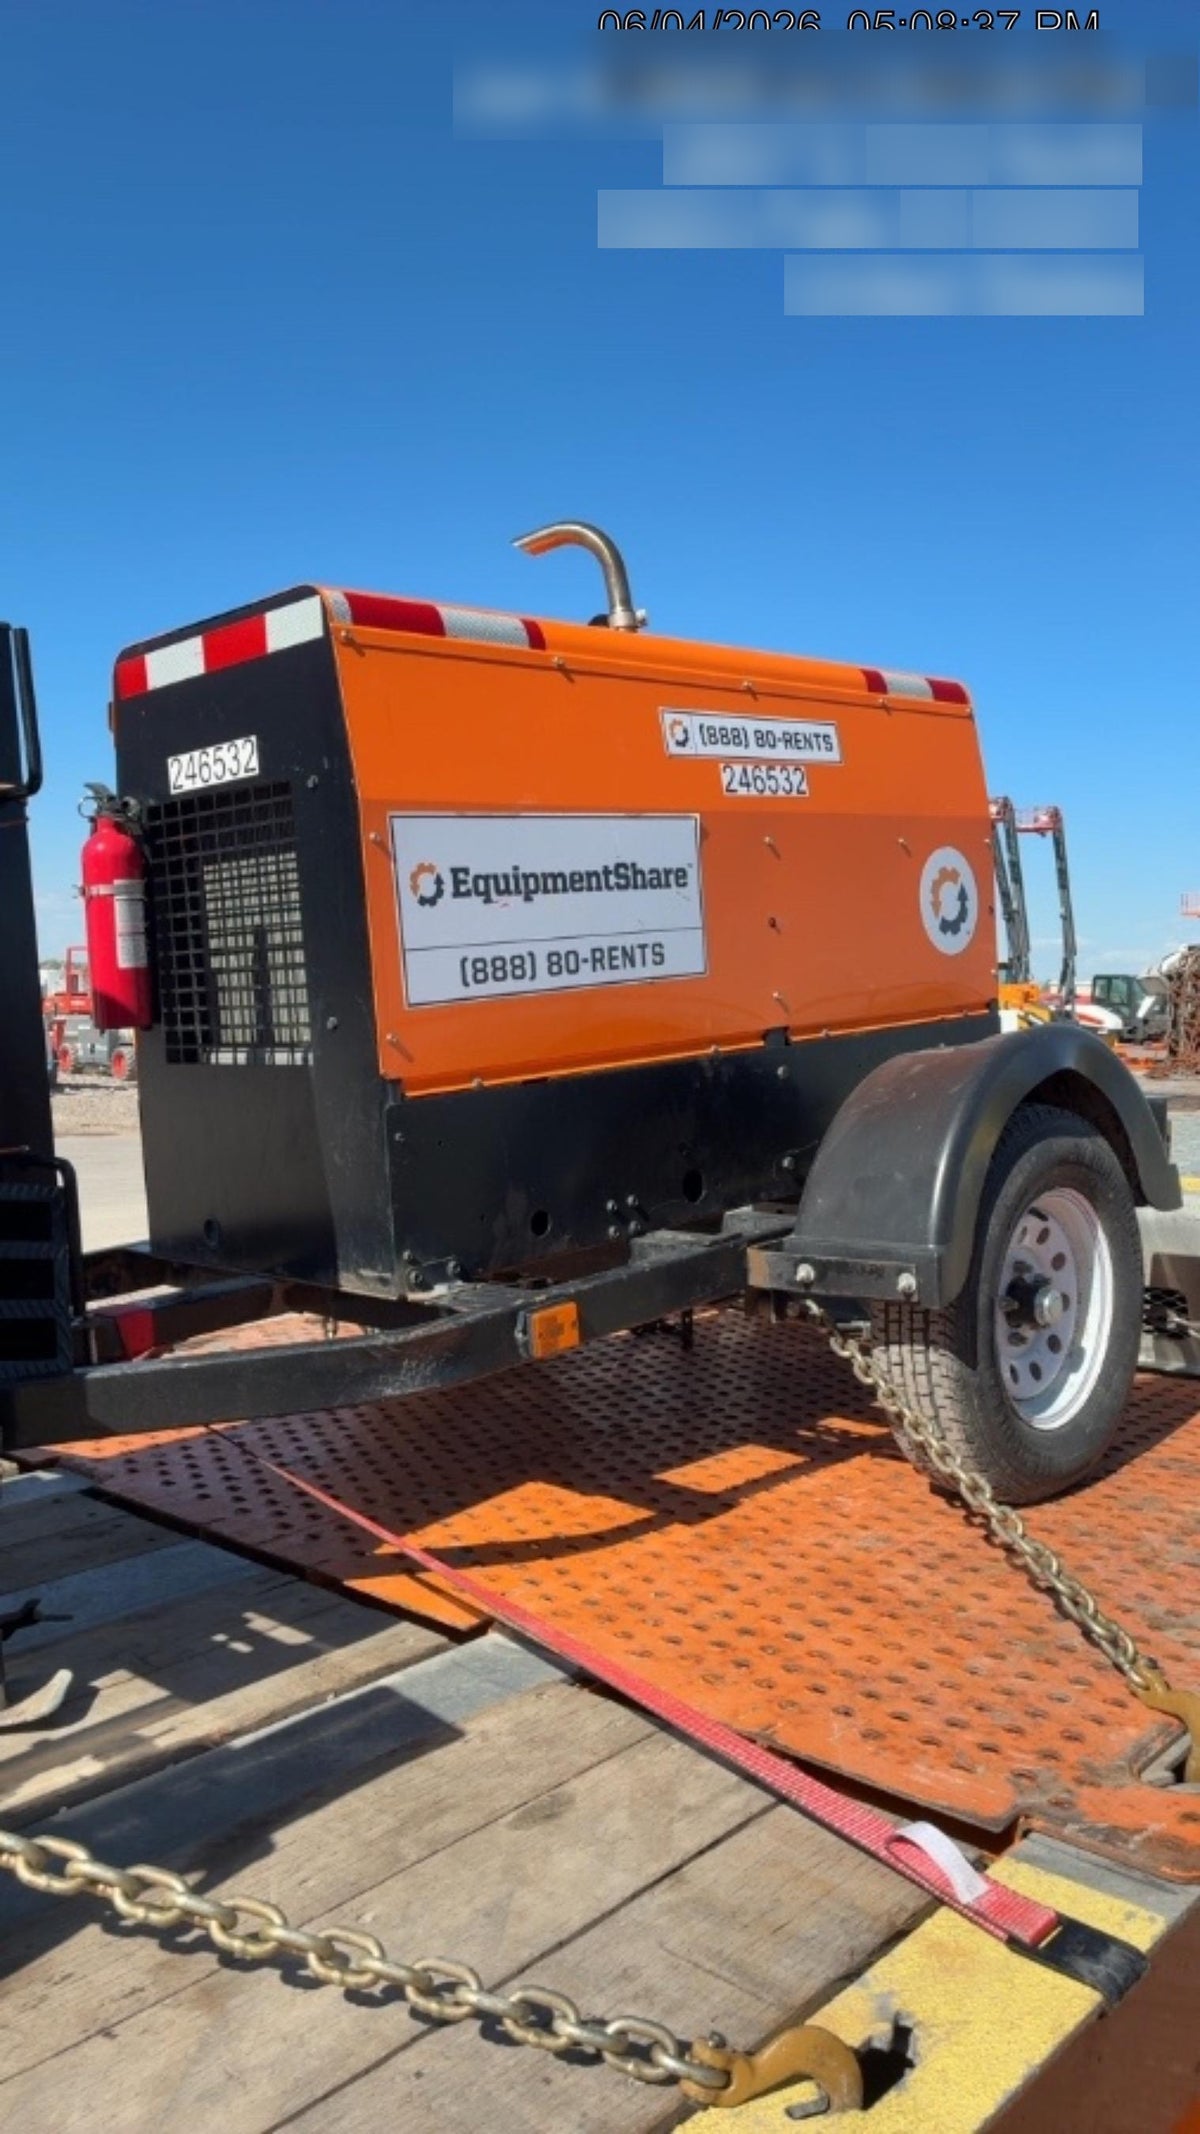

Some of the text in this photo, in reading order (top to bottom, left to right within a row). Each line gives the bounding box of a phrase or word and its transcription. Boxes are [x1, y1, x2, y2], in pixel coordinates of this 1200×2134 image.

[699, 722, 834, 752] (888) 80-RENTS
[170, 738, 257, 791] 246532
[722, 765, 807, 795] 246532
[450, 862, 688, 903] EquipmentShare
[459, 942, 666, 988] (888) 80-RENTS
